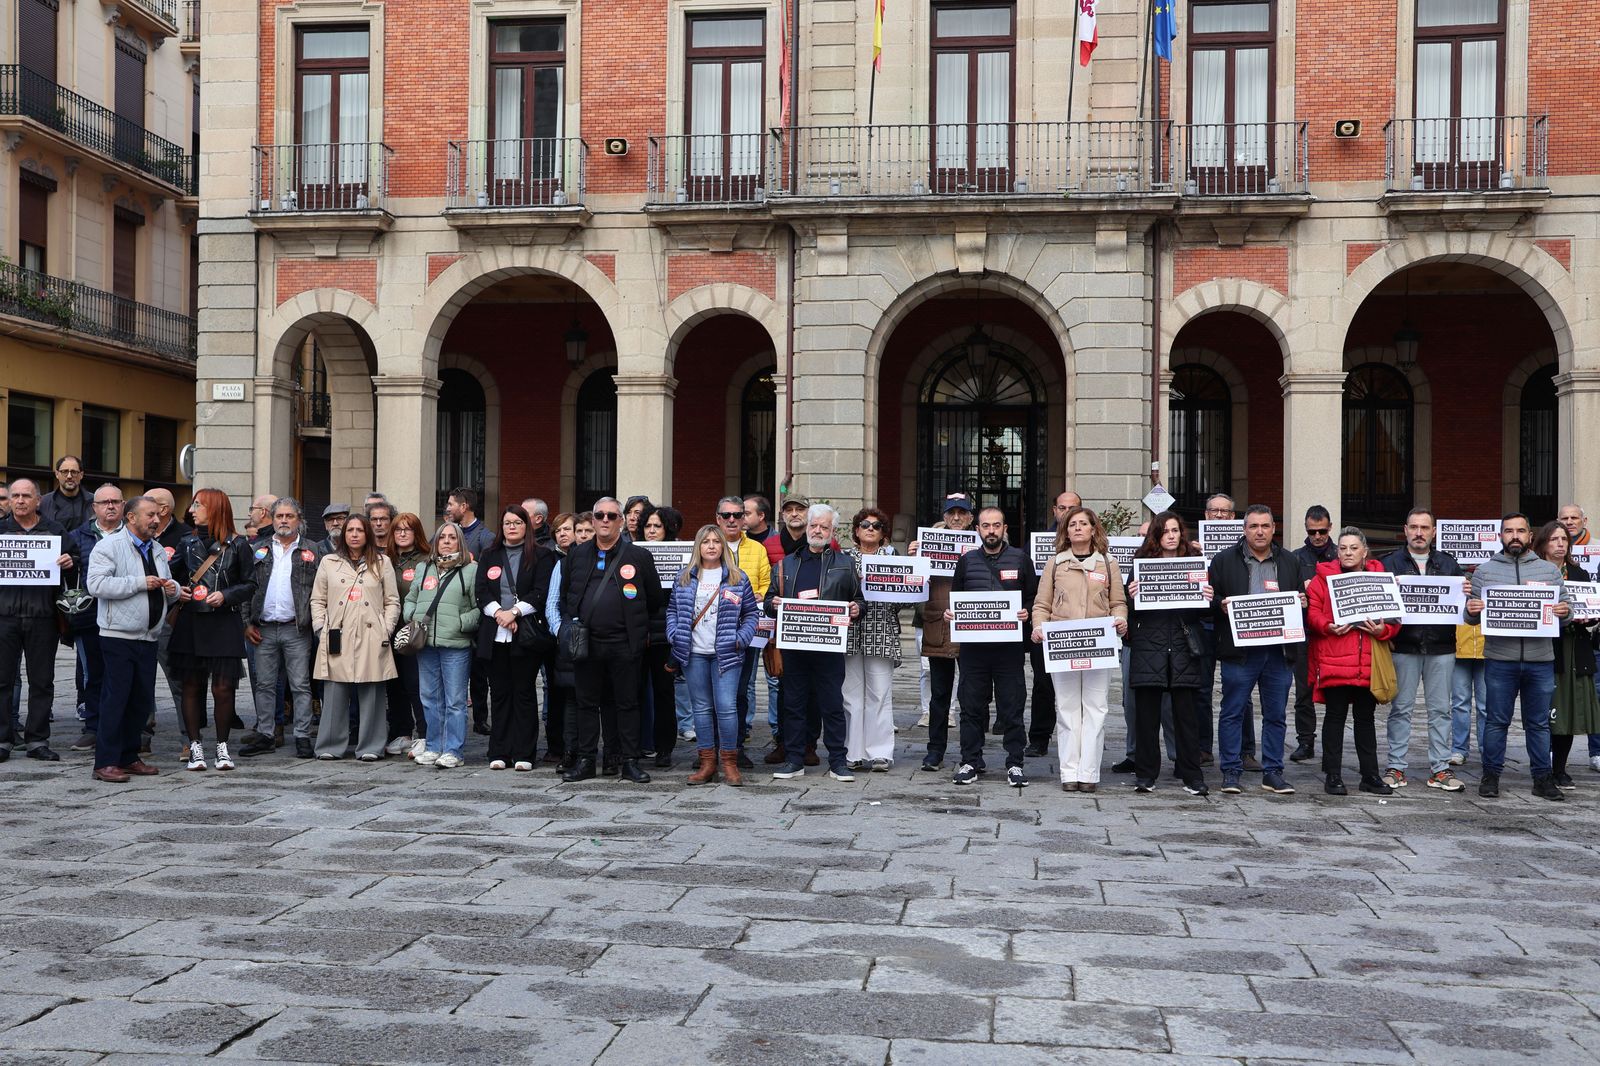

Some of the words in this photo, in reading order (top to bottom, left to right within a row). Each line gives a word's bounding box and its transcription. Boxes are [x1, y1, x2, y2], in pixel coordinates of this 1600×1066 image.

[1443, 524, 1492, 532] Solidaridad
[923, 532, 973, 543] Solidaridad
[0, 540, 48, 549] lidaridad
[940, 543, 953, 551] las
[868, 564, 878, 572] Ni
[893, 565, 911, 574] solo
[935, 561, 943, 569] la
[1141, 562, 1202, 571] Acompañamiento
[4, 570, 13, 578] la
[16, 570, 46, 578] DANA
[867, 574, 901, 583] despido
[1147, 572, 1188, 582] reparación
[1335, 576, 1391, 586] Acompañamiento
[868, 584, 882, 592] por
[884, 584, 893, 592] la
[895, 585, 921, 593] DANA
[1141, 584, 1158, 592] para
[1160, 584, 1189, 592] quienes
[1336, 589, 1341, 598] y
[1342, 584, 1382, 595] reparación
[1401, 585, 1412, 593] Ni
[1428, 586, 1447, 594] solo
[1142, 594, 1156, 602] han
[1157, 593, 1185, 603] perdido
[1186, 592, 1202, 601] todo
[1489, 590, 1554, 598] Reconocimiento
[1234, 598, 1294, 608] Reconocimiento
[1338, 597, 1355, 608] para
[1356, 594, 1384, 604] quienes
[784, 603, 843, 613] Acompañamiento
[956, 602, 1008, 610] Compromiso
[1340, 608, 1354, 616] han
[1355, 604, 1382, 614] perdido
[1406, 605, 1416, 613] or
[1429, 605, 1456, 613] DANA
[956, 611, 987, 620] político
[988, 611, 999, 619] de
[1250, 609, 1270, 617] labor
[1501, 611, 1538, 619] personas
[784, 614, 789, 622] y
[790, 614, 829, 624] reparación
[957, 621, 1016, 630] reconstrucción
[1237, 621, 1248, 629] las
[1249, 619, 1283, 629] personas
[784, 624, 800, 633] para
[801, 625, 828, 634] quienes
[829, 625, 836, 633] lo
[1049, 627, 1103, 639] Compromiso
[1239, 629, 1281, 638] voluntarias
[798, 635, 823, 645] perdido
[1050, 639, 1082, 651] político
[1083, 640, 1094, 648] de
[1051, 651, 1112, 660] reconstrucción
